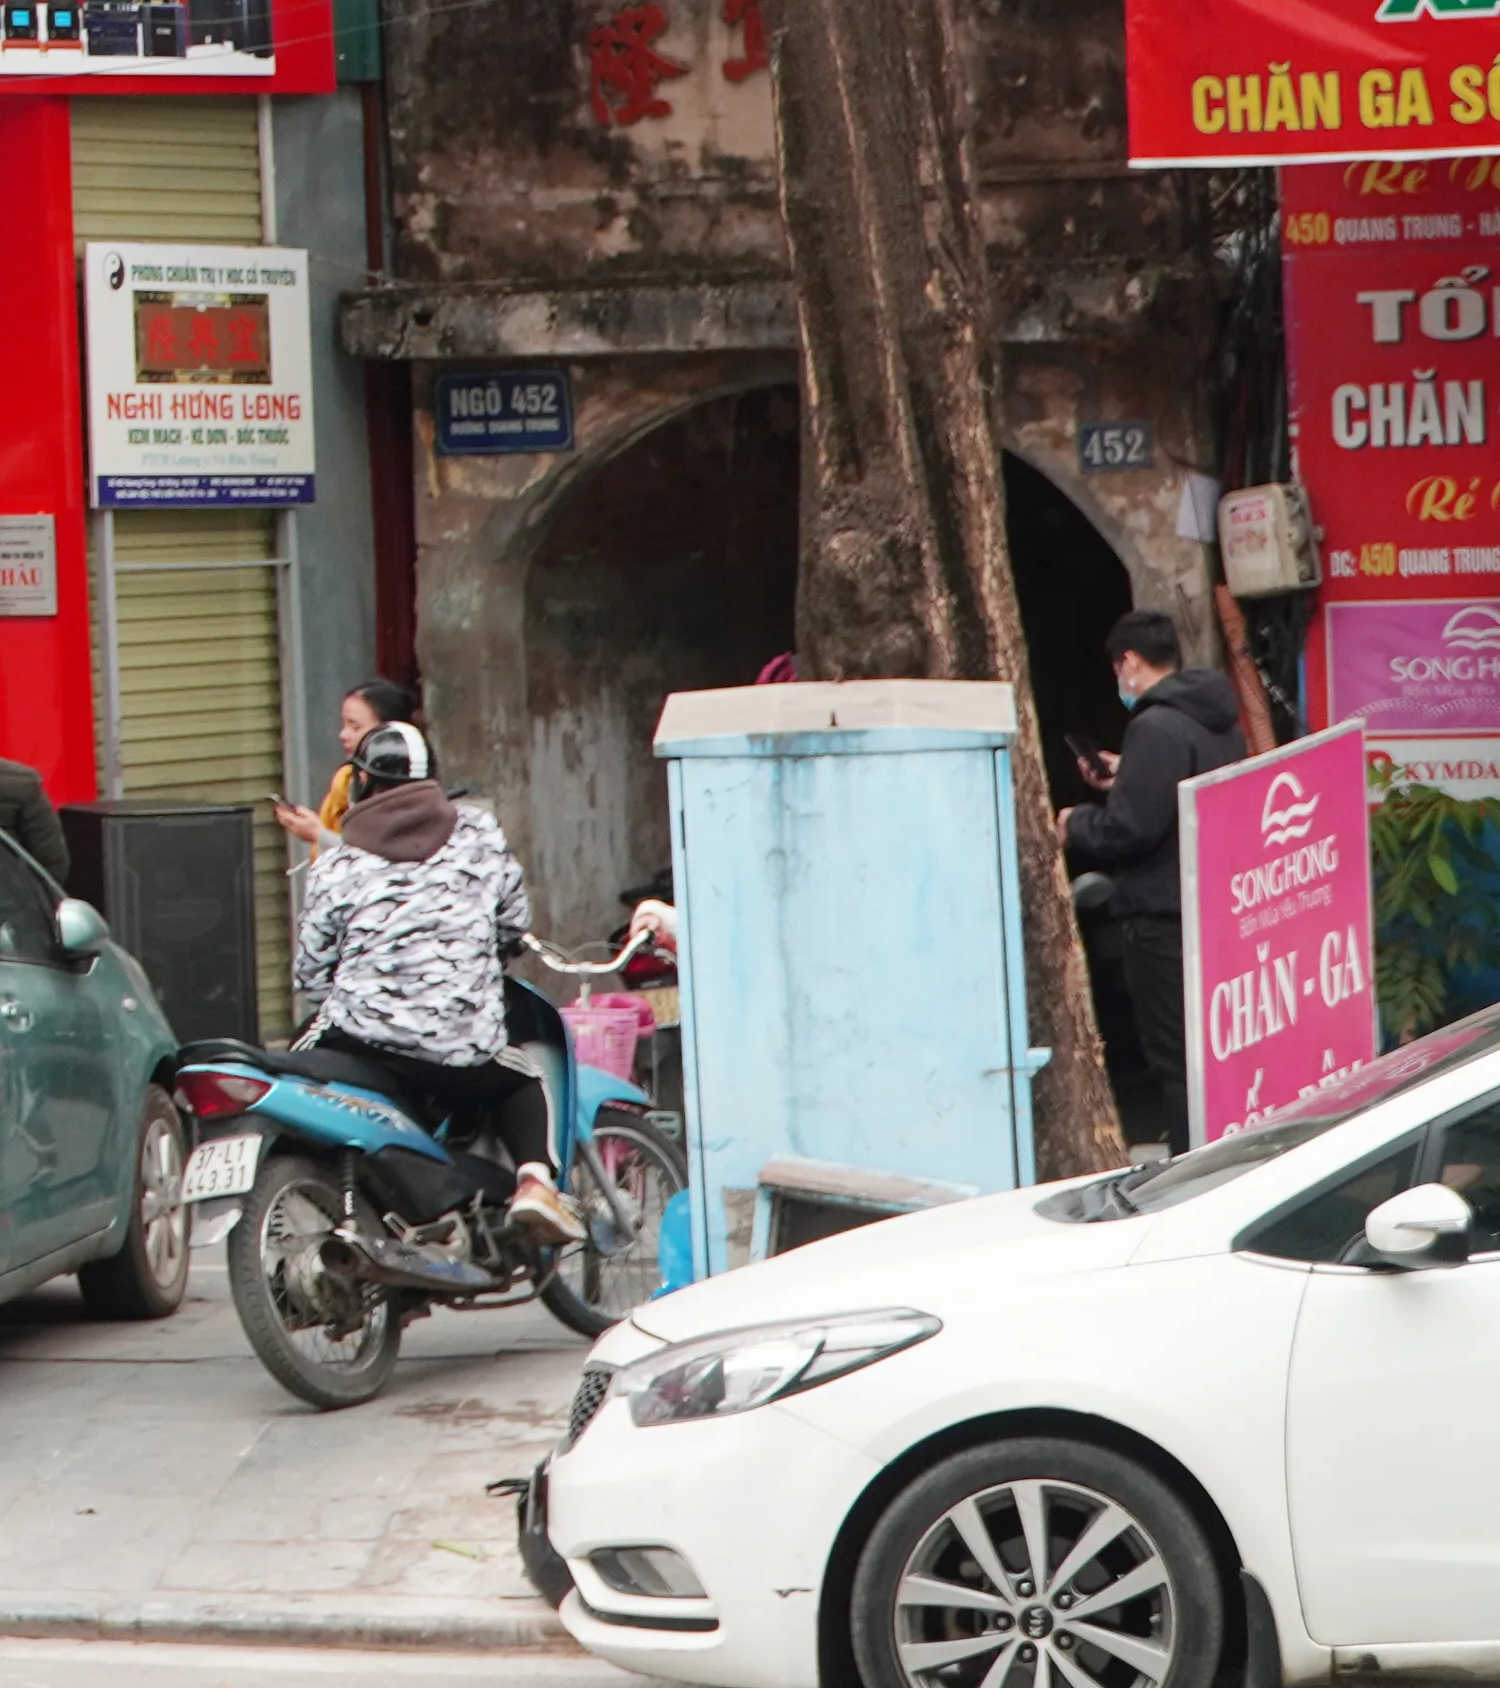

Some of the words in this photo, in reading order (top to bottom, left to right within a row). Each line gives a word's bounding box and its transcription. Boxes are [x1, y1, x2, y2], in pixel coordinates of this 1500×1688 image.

[1190, 61, 1342, 135] CHĂN
[1357, 63, 1432, 131] GA
[509, 383, 559, 415] 452
[1084, 429, 1145, 466] 452
